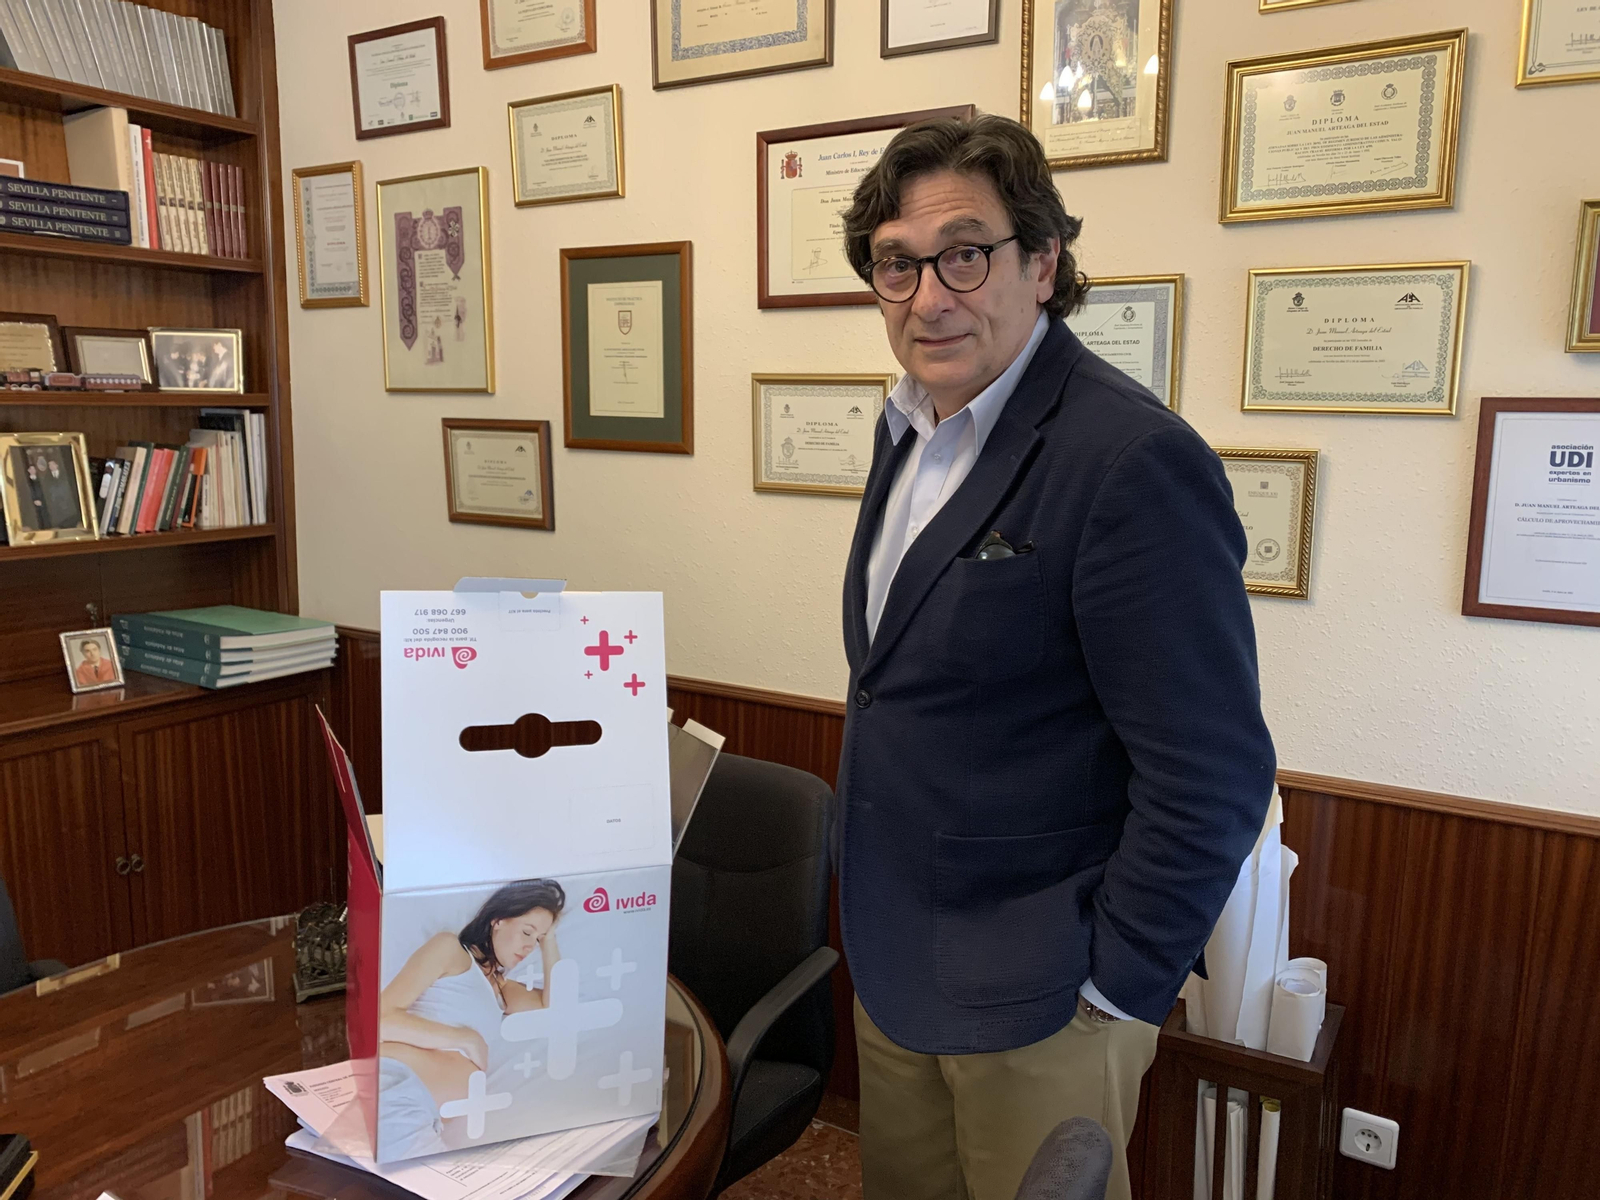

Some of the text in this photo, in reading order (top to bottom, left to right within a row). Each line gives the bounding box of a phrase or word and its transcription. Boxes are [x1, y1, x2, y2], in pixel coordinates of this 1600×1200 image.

[1302, 126, 1326, 134] MANUEL
[1328, 124, 1356, 132] ARTEAGA
[1312, 115, 1360, 126] DIPLOMA
[818, 152, 832, 162] Juan
[833, 150, 852, 160] Carlos
[858, 148, 870, 158] Rey
[870, 148, 878, 156] de
[8, 182, 50, 196] SEVILLA
[51, 189, 106, 204] PENITENTE
[8, 201, 50, 214] SEVILLA
[52, 206, 107, 221] PENITENTE
[12, 217, 53, 230] SEVILLA
[56, 223, 110, 237] PENITENTE
[1550, 450, 1594, 468] UDI
[404, 647, 445, 662] ivida
[616, 892, 656, 910] ivida
